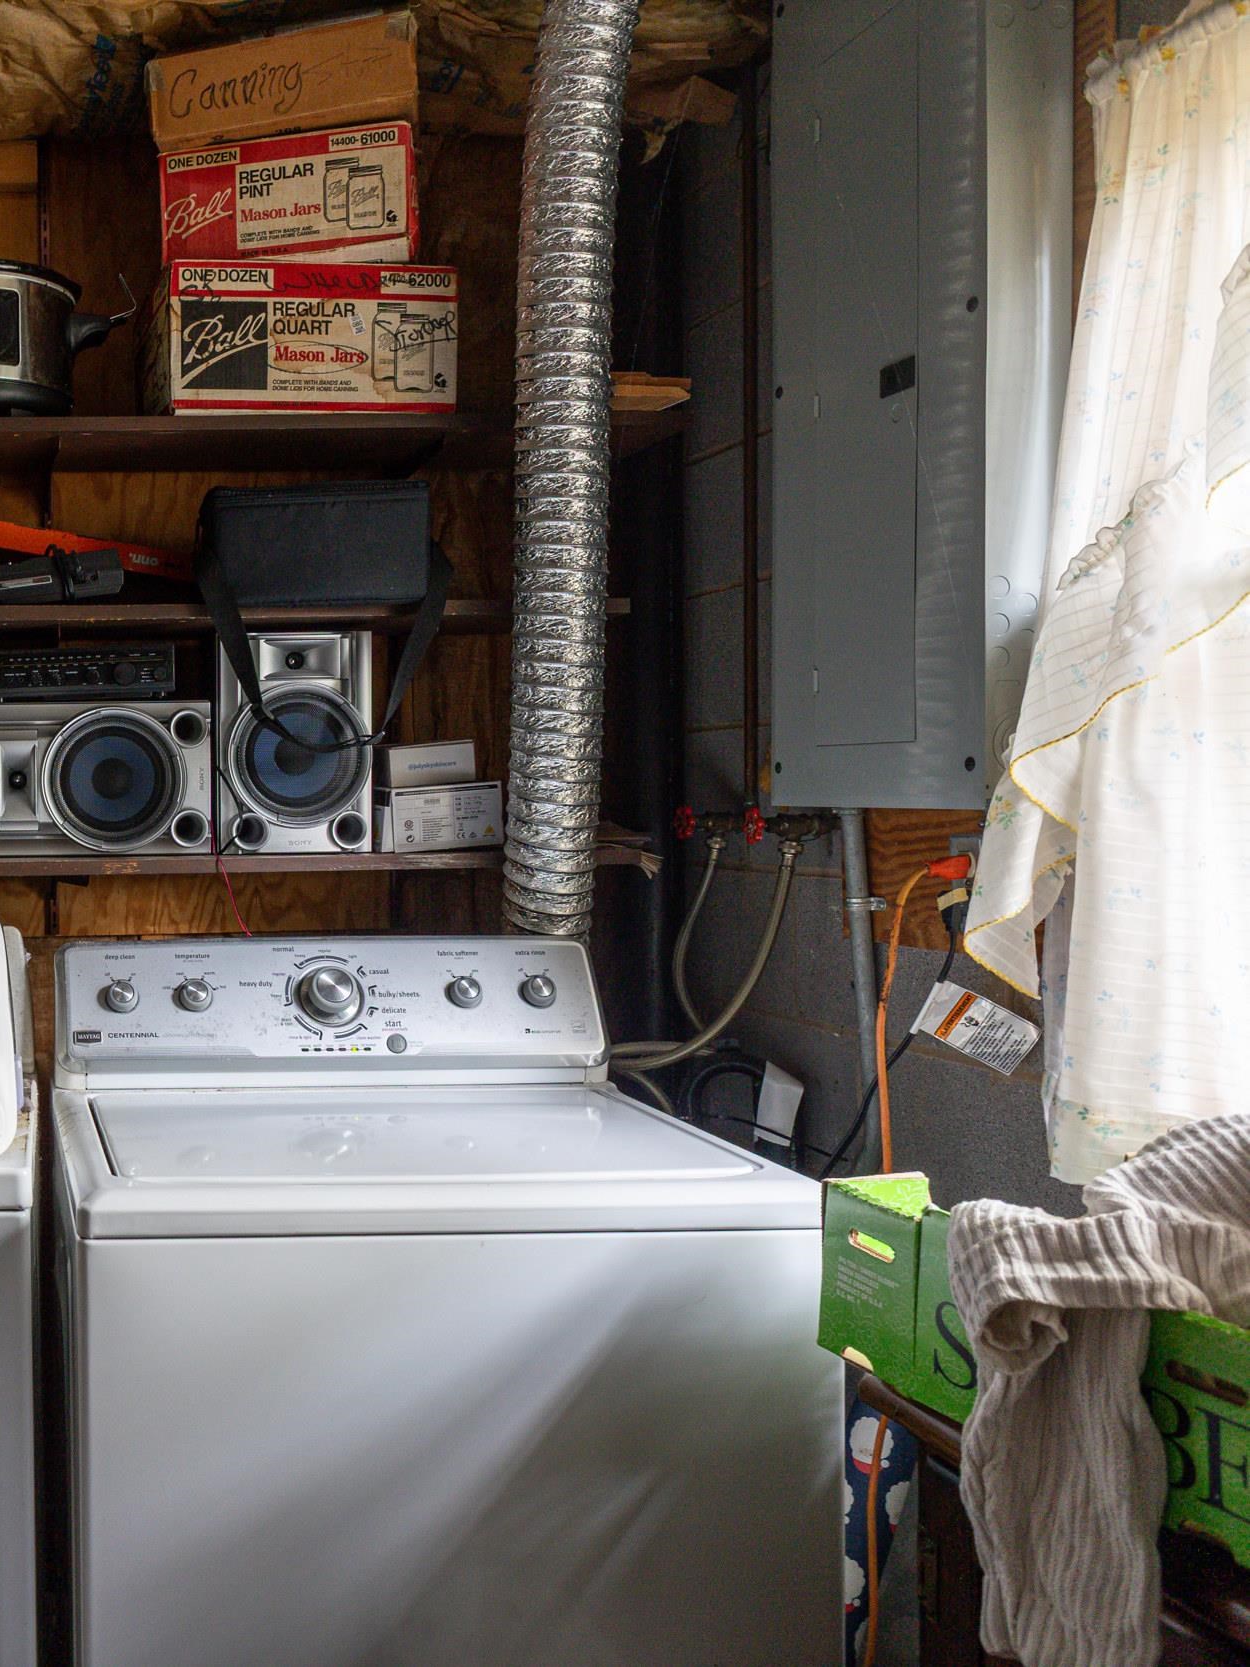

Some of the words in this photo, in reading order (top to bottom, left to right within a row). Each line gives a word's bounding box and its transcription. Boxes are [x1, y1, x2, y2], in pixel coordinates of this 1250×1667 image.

[169, 61, 303, 118] Canning
[168, 155, 195, 170] ONE
[196, 150, 238, 166] DOZEN
[239, 162, 314, 185] REGULAR
[239, 183, 273, 200] PINT
[165, 188, 233, 240] Ball
[240, 206, 288, 224] Mason
[289, 201, 322, 219] Jars
[240, 230, 267, 239] COMPLETE
[281, 231, 296, 239] HOME
[181, 268, 214, 283] ONE
[217, 269, 269, 284] DOZEN
[273, 301, 355, 318] REGULAR
[273, 320, 331, 335] QUART
[182, 313, 268, 378] Ball
[274, 345, 326, 363] Mason
[330, 345, 365, 364] Jars
[239, 980, 257, 988] heavy
[258, 980, 273, 988] duty
[378, 990, 420, 998] bulky/sheets
